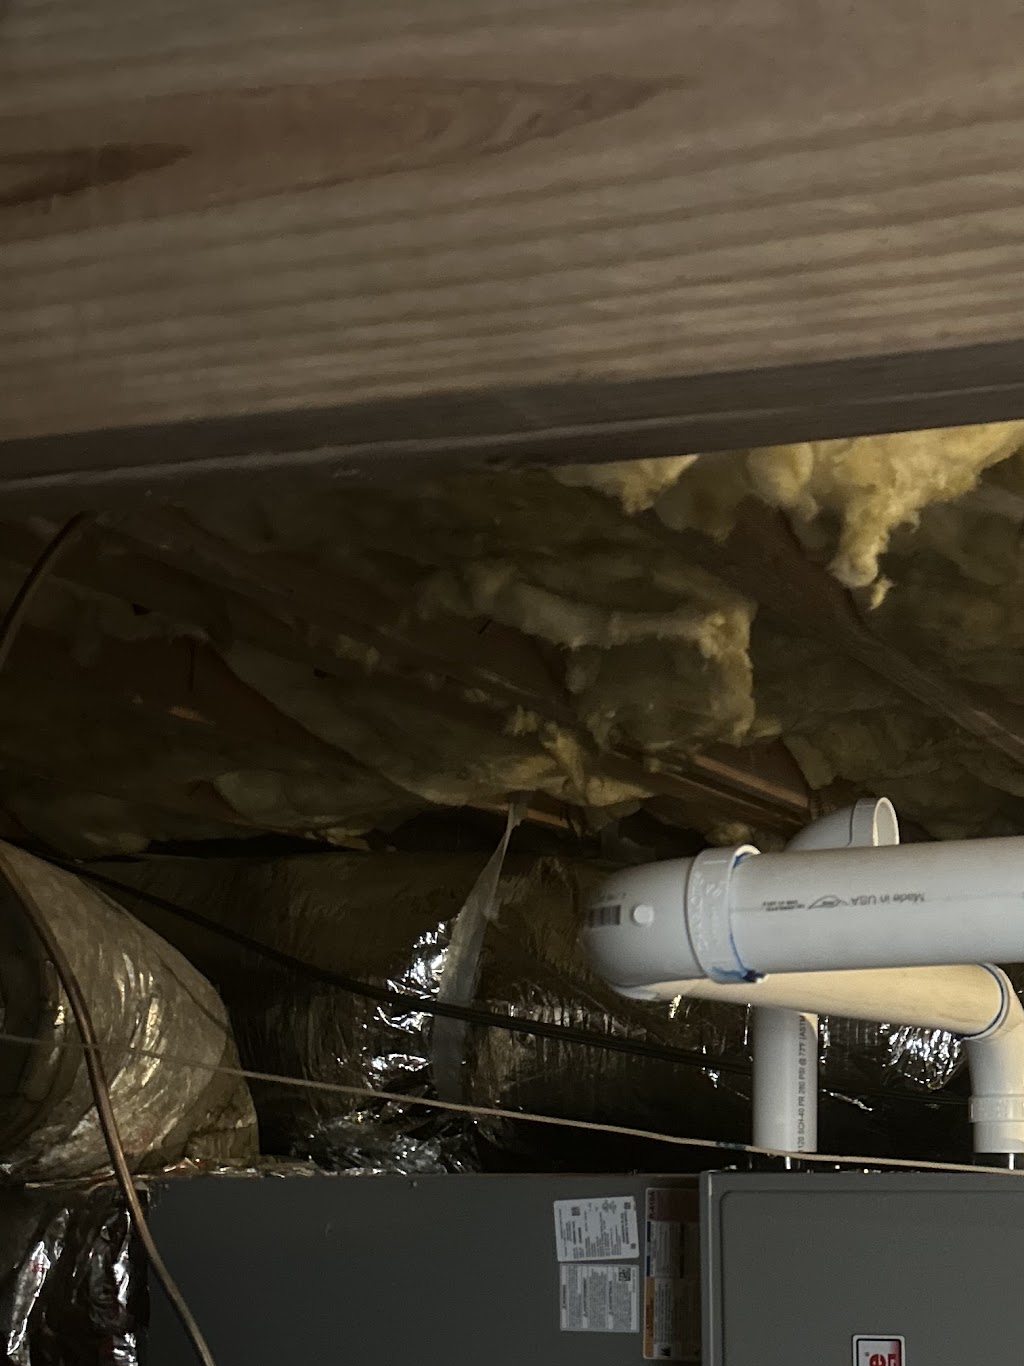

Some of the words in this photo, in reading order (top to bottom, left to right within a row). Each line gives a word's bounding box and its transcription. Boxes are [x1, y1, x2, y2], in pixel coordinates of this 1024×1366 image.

[850, 894, 875, 906] USA
[876, 894, 889, 904] in
[892, 892, 926, 903] Made
